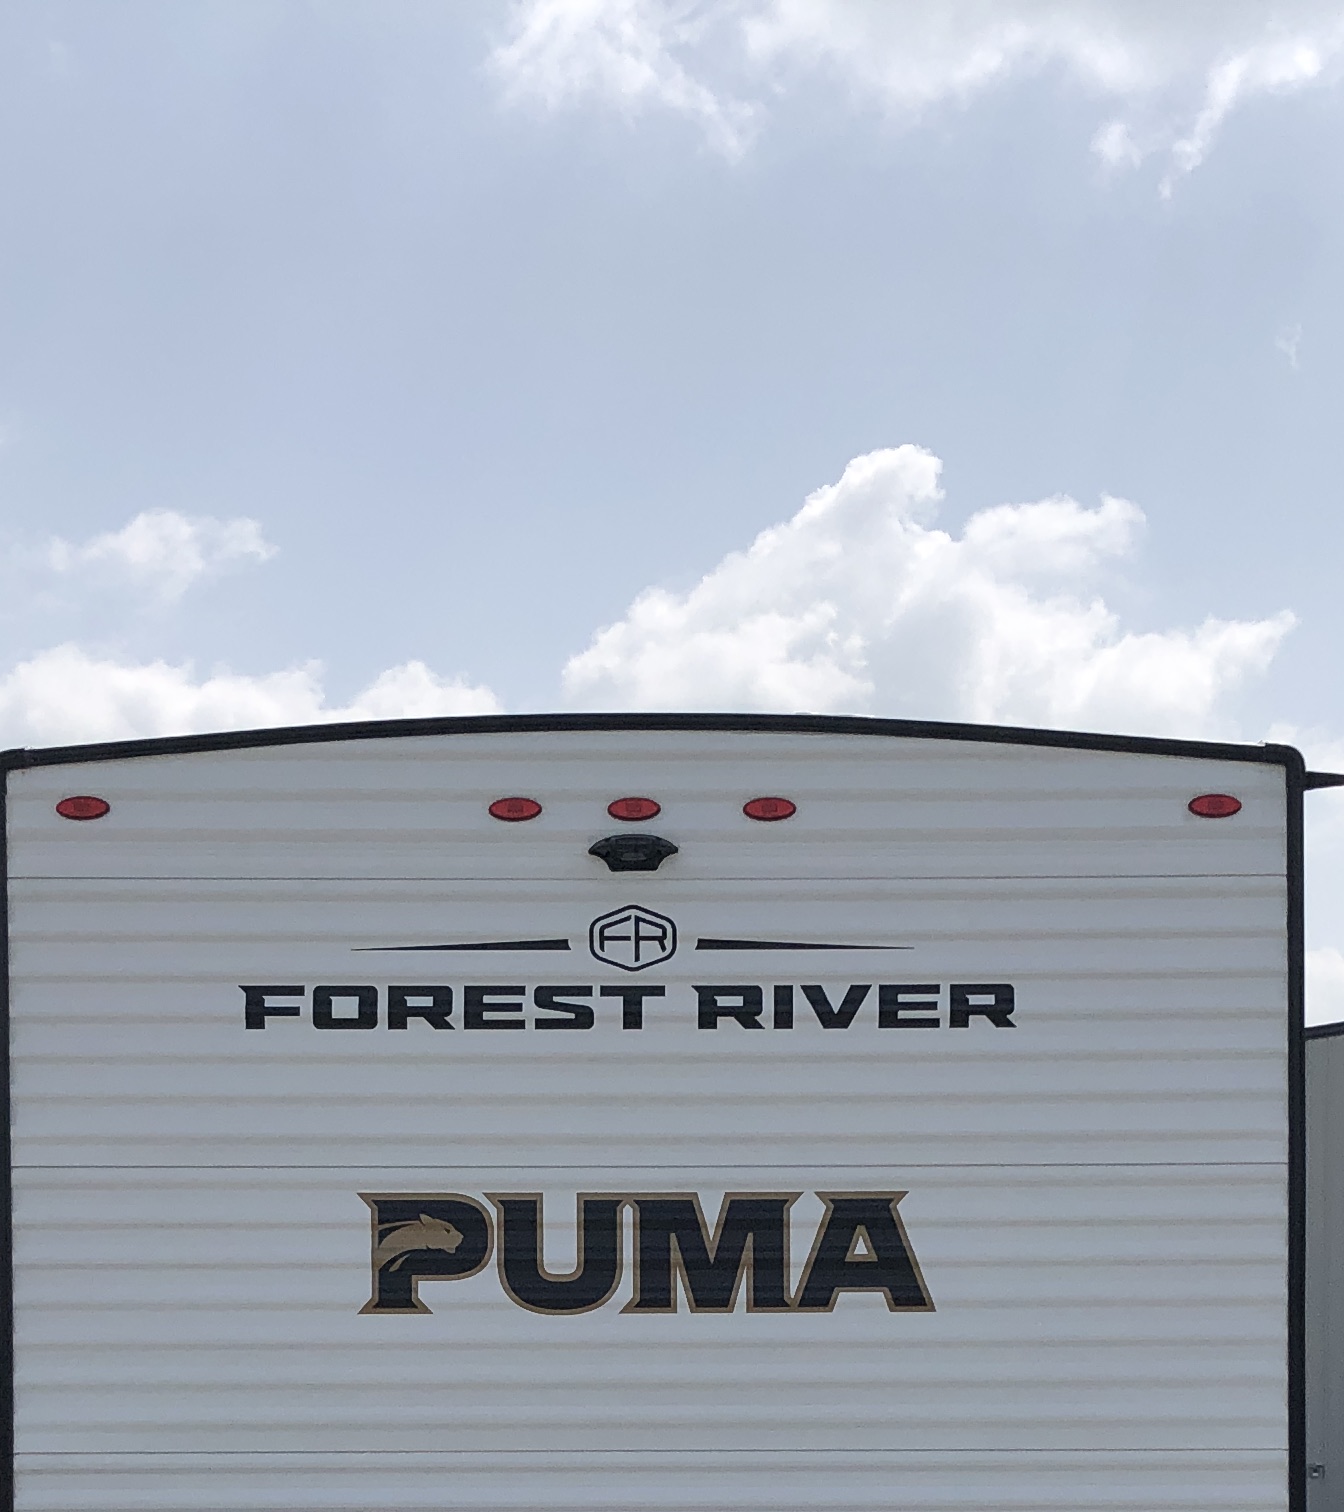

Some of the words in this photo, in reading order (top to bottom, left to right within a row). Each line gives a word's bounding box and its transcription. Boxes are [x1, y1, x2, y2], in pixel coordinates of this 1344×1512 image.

[599, 913, 668, 963] FR
[238, 985, 666, 1030] FOREST
[691, 983, 1017, 1030] RIVER
[357, 1191, 937, 1316] PUMA
